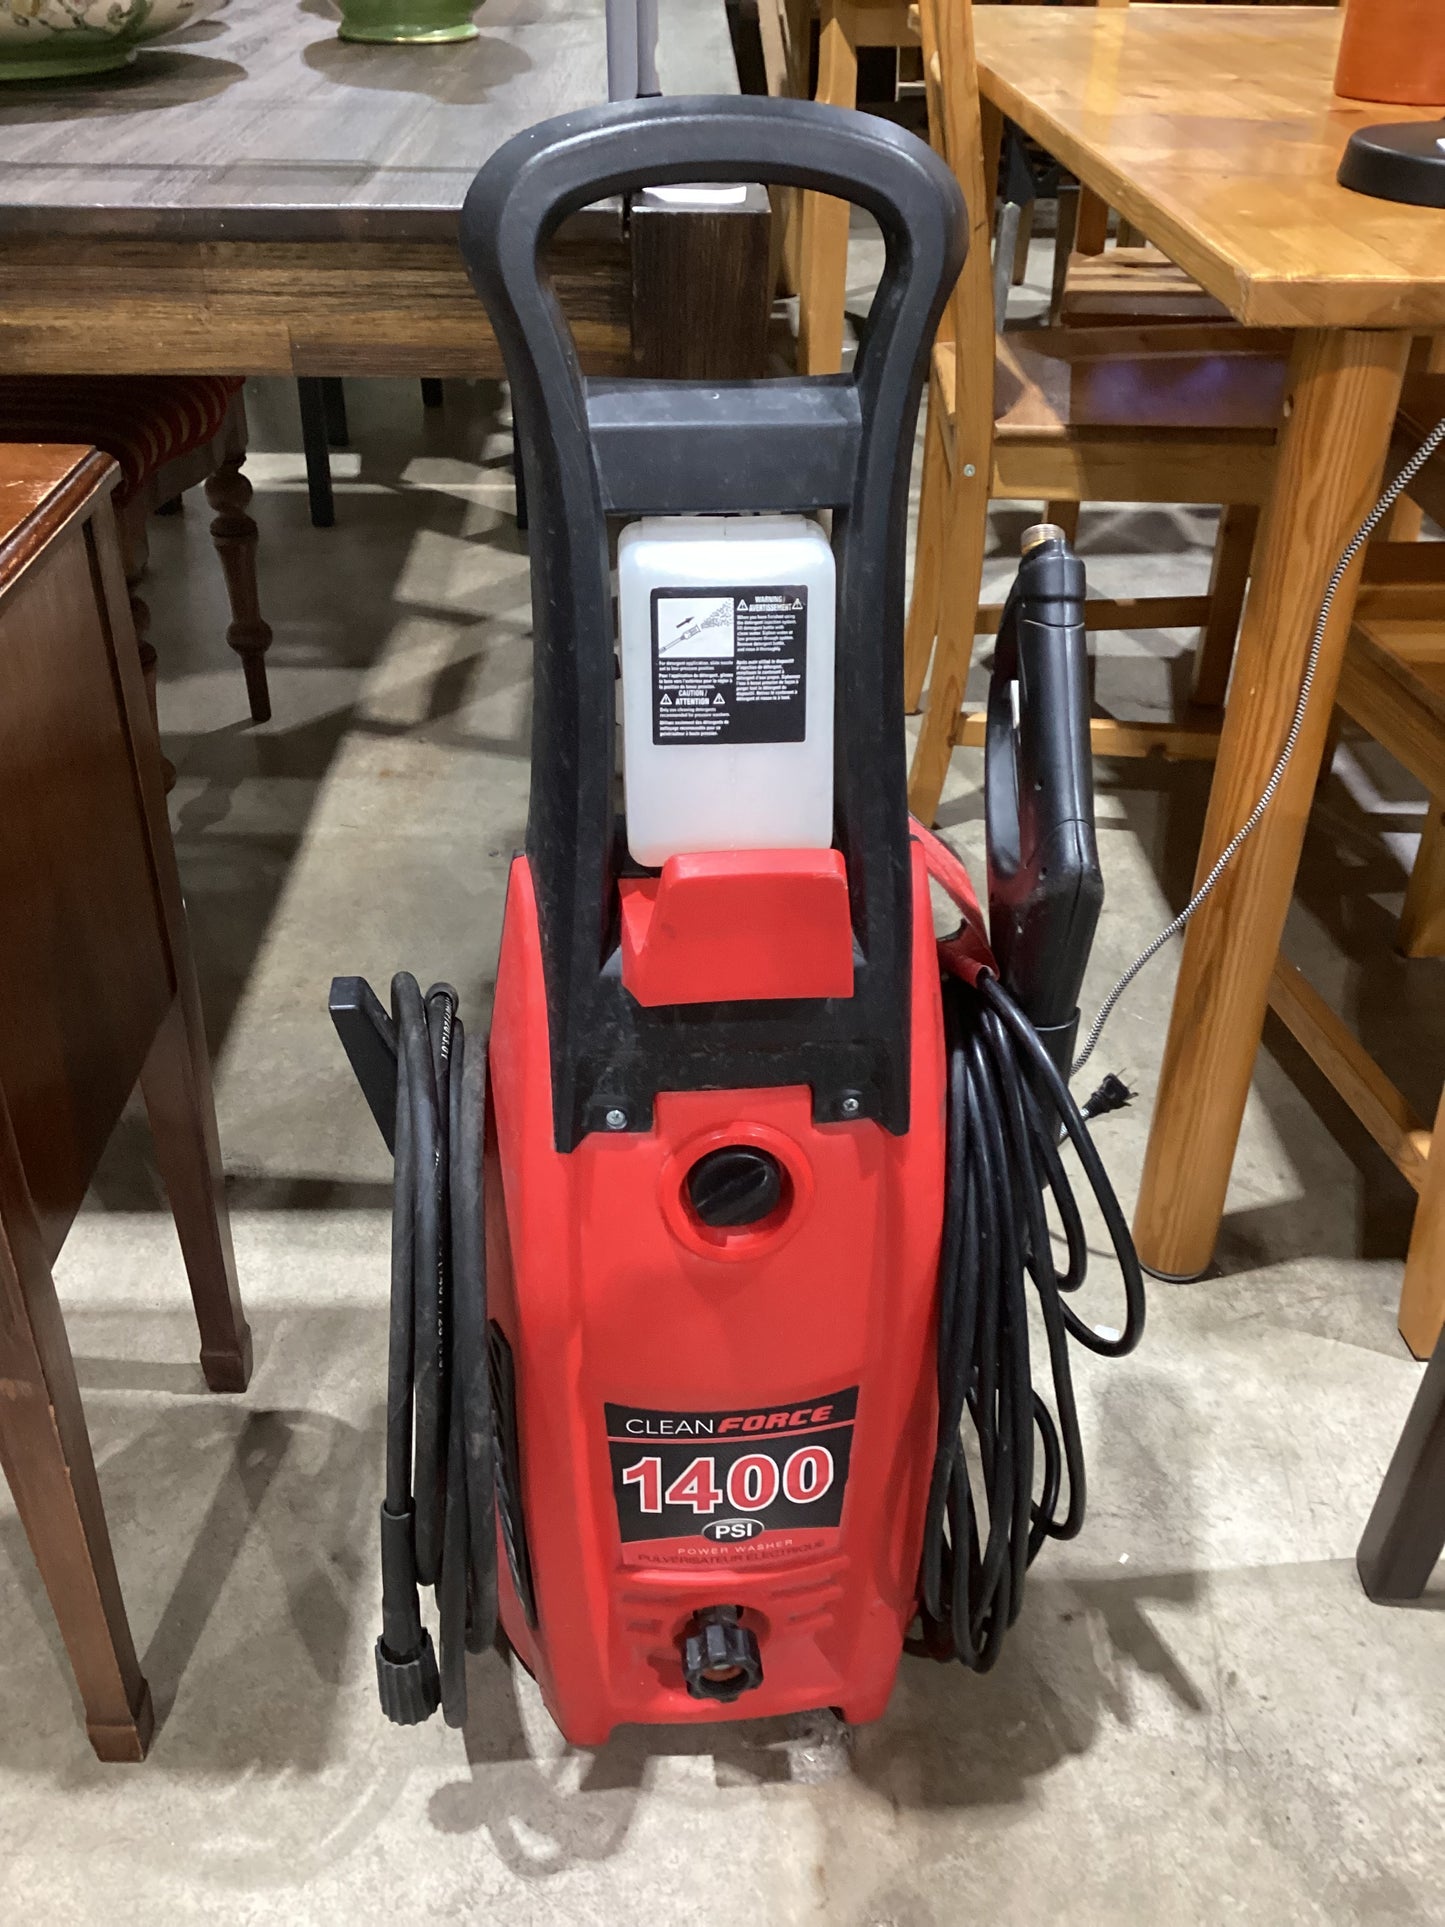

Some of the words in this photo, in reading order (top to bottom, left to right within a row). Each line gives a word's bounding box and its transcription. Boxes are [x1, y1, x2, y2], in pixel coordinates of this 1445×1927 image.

[748, 604, 792, 612] AVERTISSEMENT
[625, 1418, 714, 1435] CLEAN
[717, 1404, 834, 1434] FORCE
[622, 1445, 834, 1514] 1400
[715, 1523, 753, 1540] PSI
[677, 1547, 730, 1556] POWER
[735, 1539, 793, 1554] WASHER
